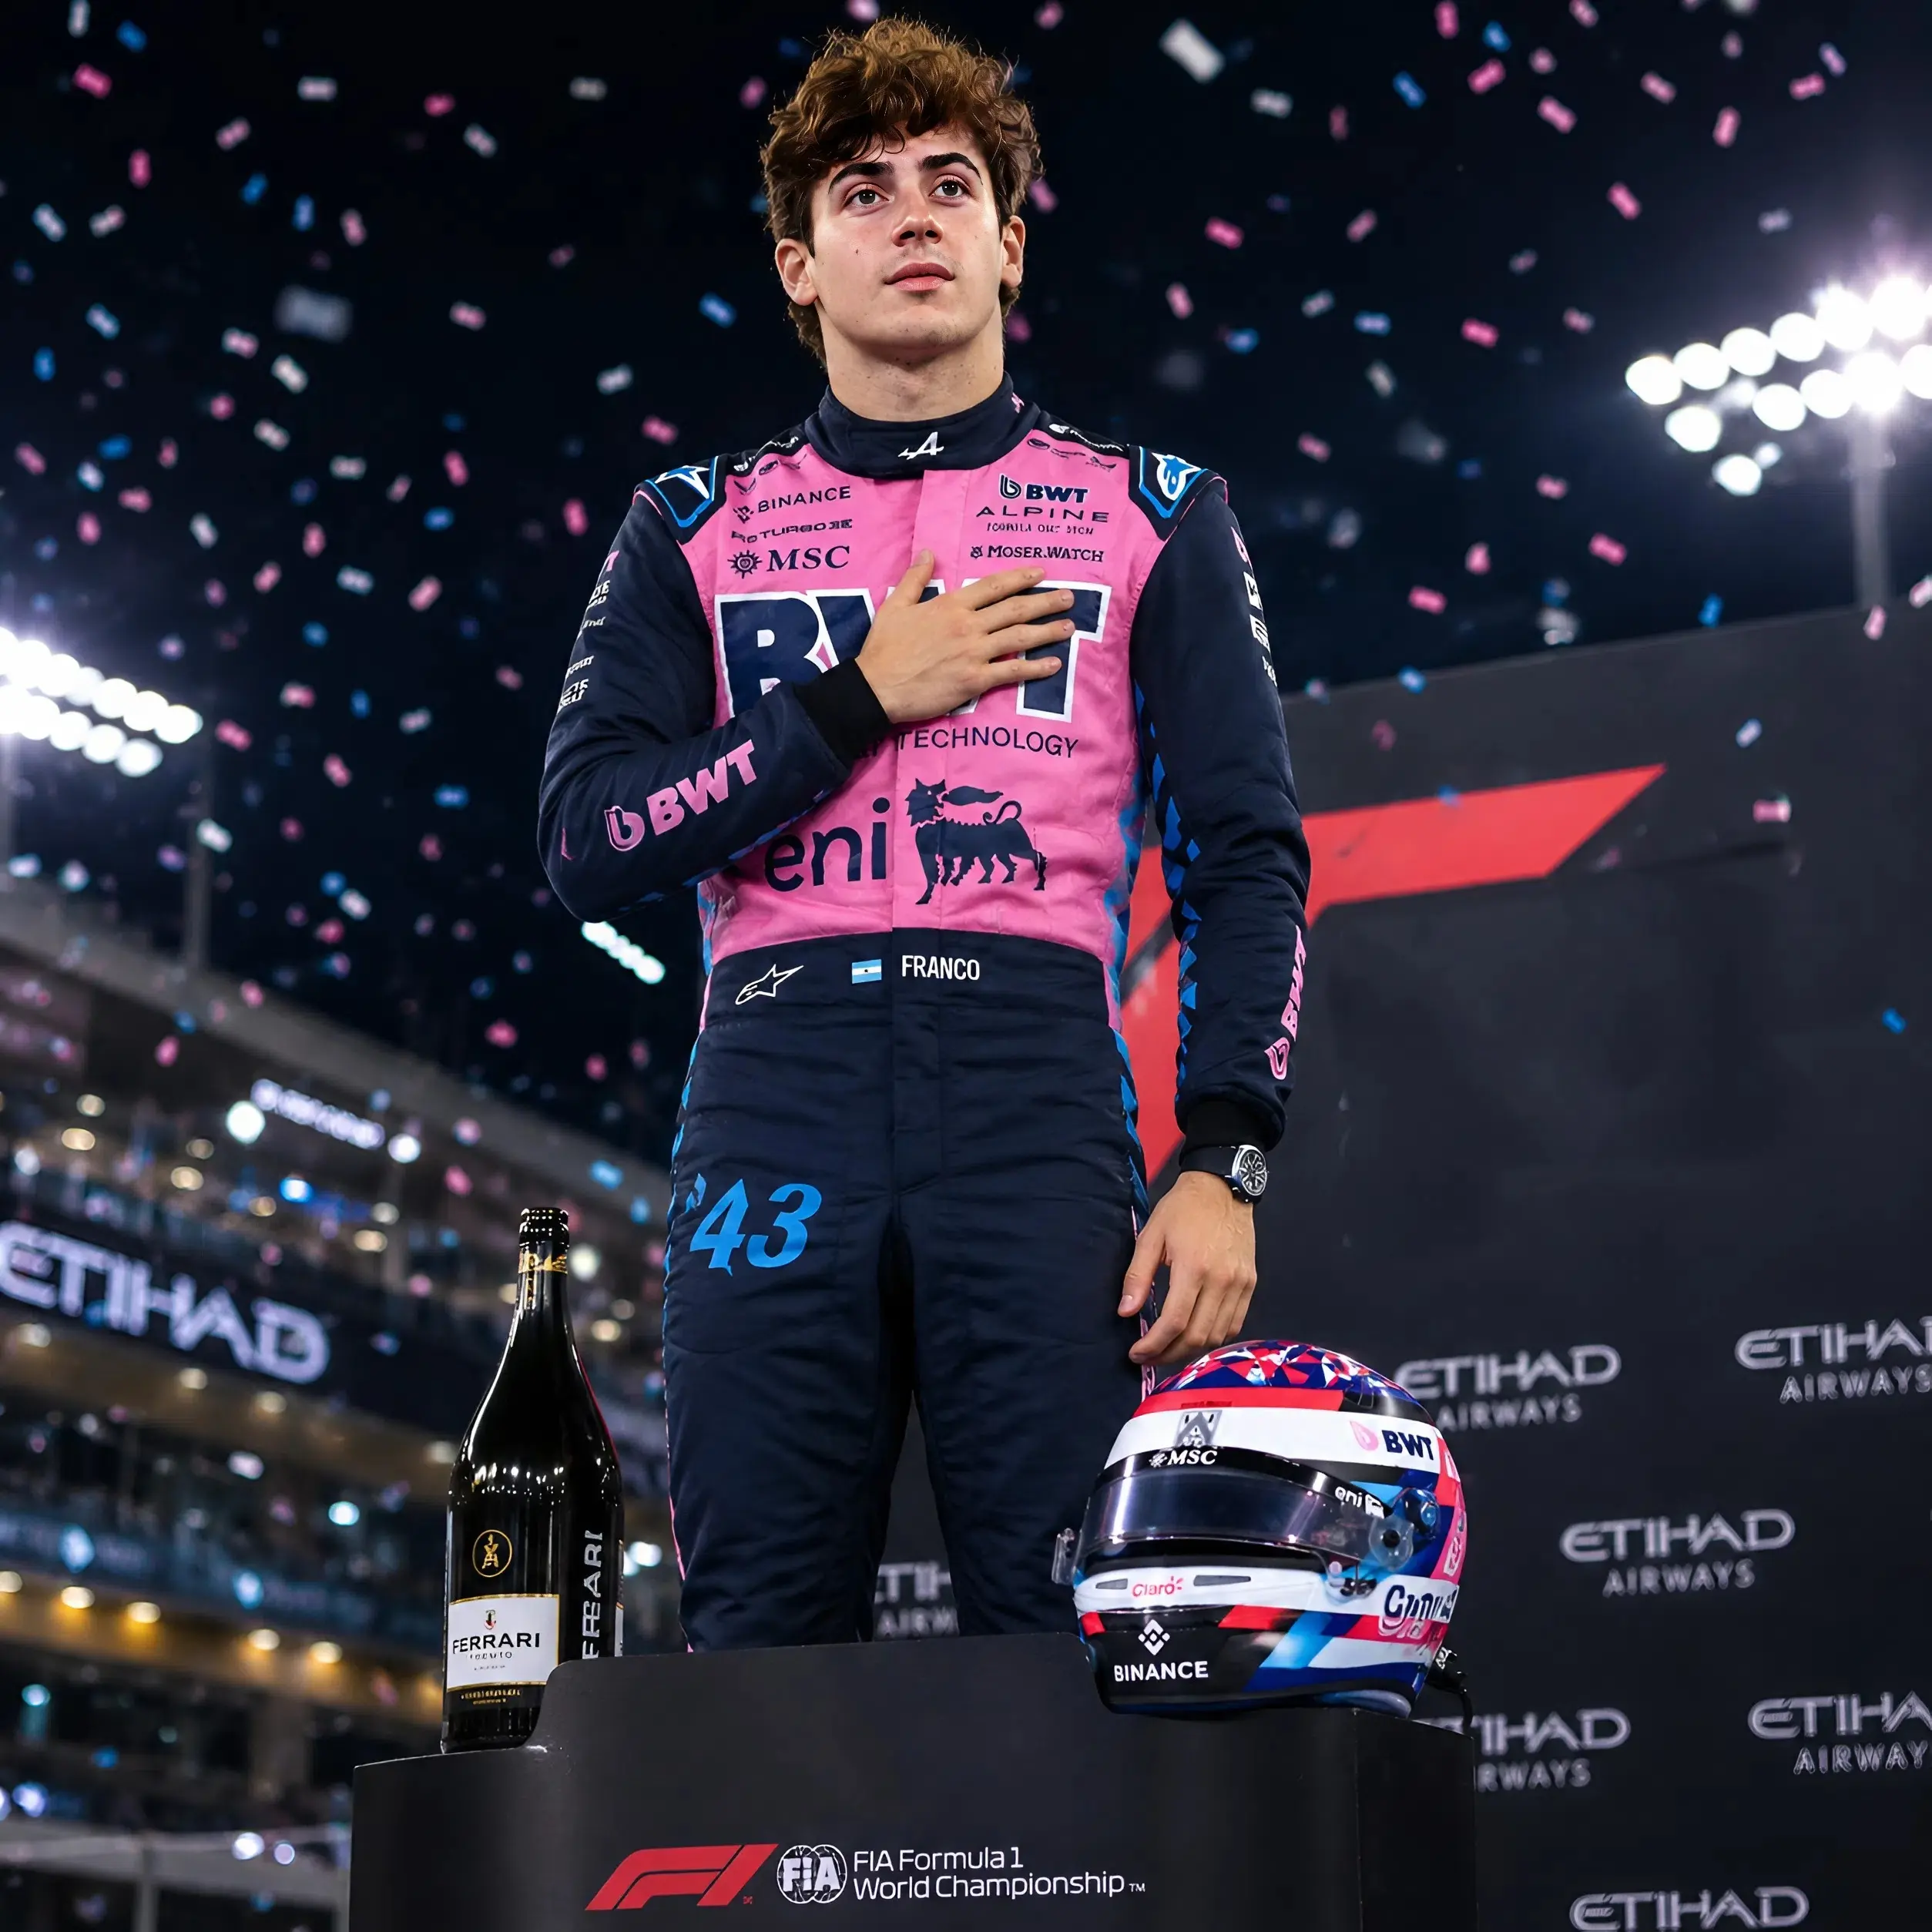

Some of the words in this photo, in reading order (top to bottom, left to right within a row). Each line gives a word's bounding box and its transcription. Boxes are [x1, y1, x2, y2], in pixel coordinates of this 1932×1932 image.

[758, 485, 851, 514] BINANCE
[1026, 483, 1088, 504] BWT
[976, 505, 1109, 523] ALPINE
[766, 545, 850, 572] MSC
[715, 579, 1112, 723] BT
[897, 726, 1078, 758] TECHNOLOGY
[646, 739, 758, 837] BWT
[764, 797, 889, 892] eni
[901, 954, 981, 981] FRANCO
[0, 1220, 331, 1384] ETIHAD
[1393, 1344, 1622, 1400] ETIHAD
[1435, 1393, 1582, 1431] AIRWAYS
[1167, 1449, 1218, 1466] MSC
[1382, 1430, 1434, 1461] BWT
[1559, 1509, 1796, 1563] ETIHAD
[1132, 1581, 1176, 1598] Claro
[1602, 1558, 1755, 1598] AIRWAYS
[452, 1632, 540, 1655] FERRARI
[1114, 1660, 1209, 1682] BINANCE
[1747, 1690, 1932, 1741] ETIHA
[1793, 1739, 1929, 1775] AIRWAY
[1477, 1758, 1592, 1793] RWAYS
[782, 1856, 842, 1893] FIA
[854, 1849, 894, 1872] FIA
[899, 1846, 1005, 1871] Formula
[1010, 1846, 1024, 1869] 1
[853, 1875, 930, 1900] World
[935, 1870, 1125, 1900] Championship
[1569, 1886, 1810, 1932] ETIHAD
